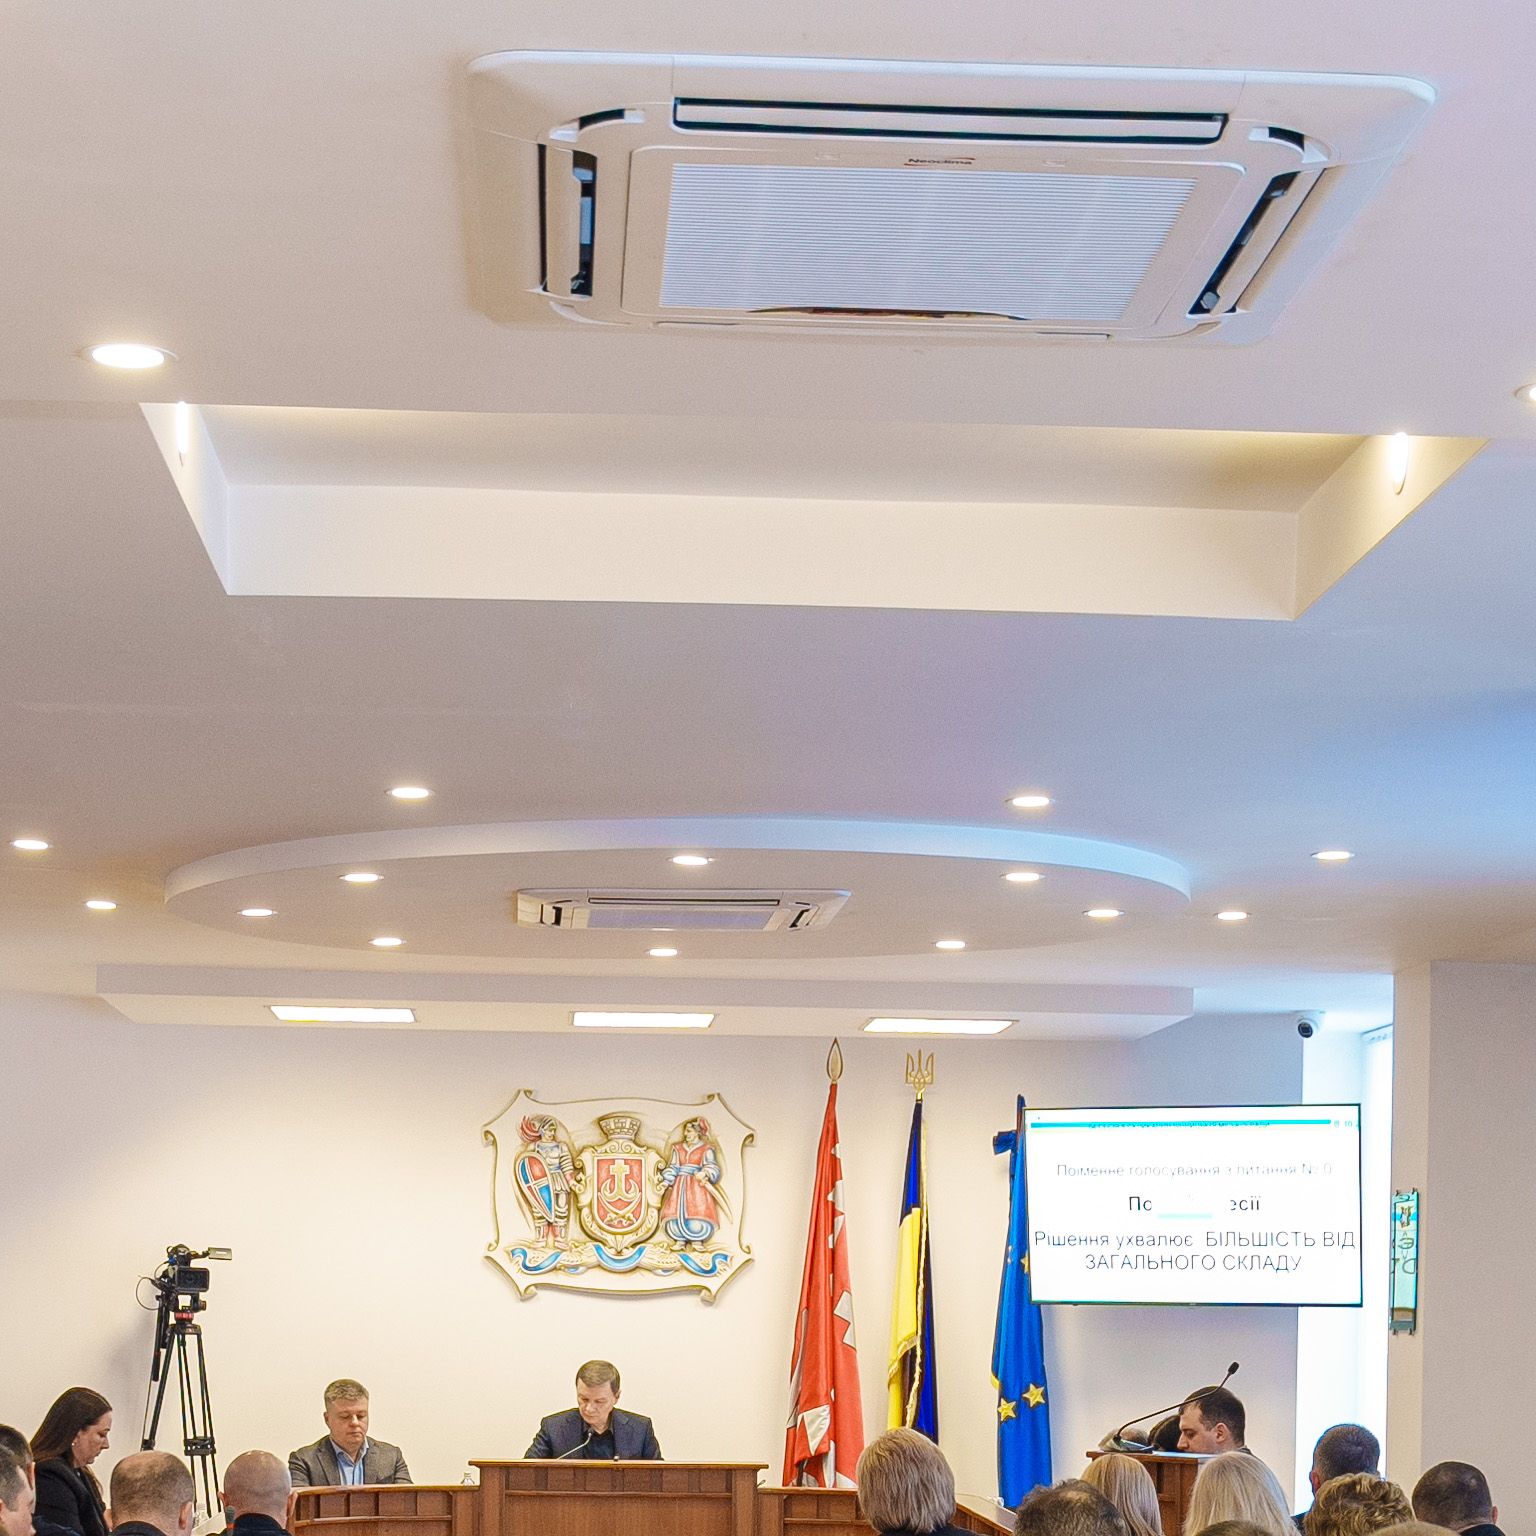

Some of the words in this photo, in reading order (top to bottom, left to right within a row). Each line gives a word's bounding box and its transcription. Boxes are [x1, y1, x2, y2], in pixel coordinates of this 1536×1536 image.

[1057, 1164, 1125, 1177] Поіменне
[1129, 1196, 1152, 1211] По
[1229, 1195, 1261, 1211] есії
[1034, 1230, 1109, 1247] Рішення
[1115, 1234, 1194, 1251] ухвалює
[1206, 1231, 1316, 1247] БІЛЬШІСТЬ
[1323, 1231, 1355, 1250] ВІД
[1085, 1254, 1216, 1270] ЗАГАЛЬНОГО
[1222, 1254, 1302, 1273] СКЛАДУ
